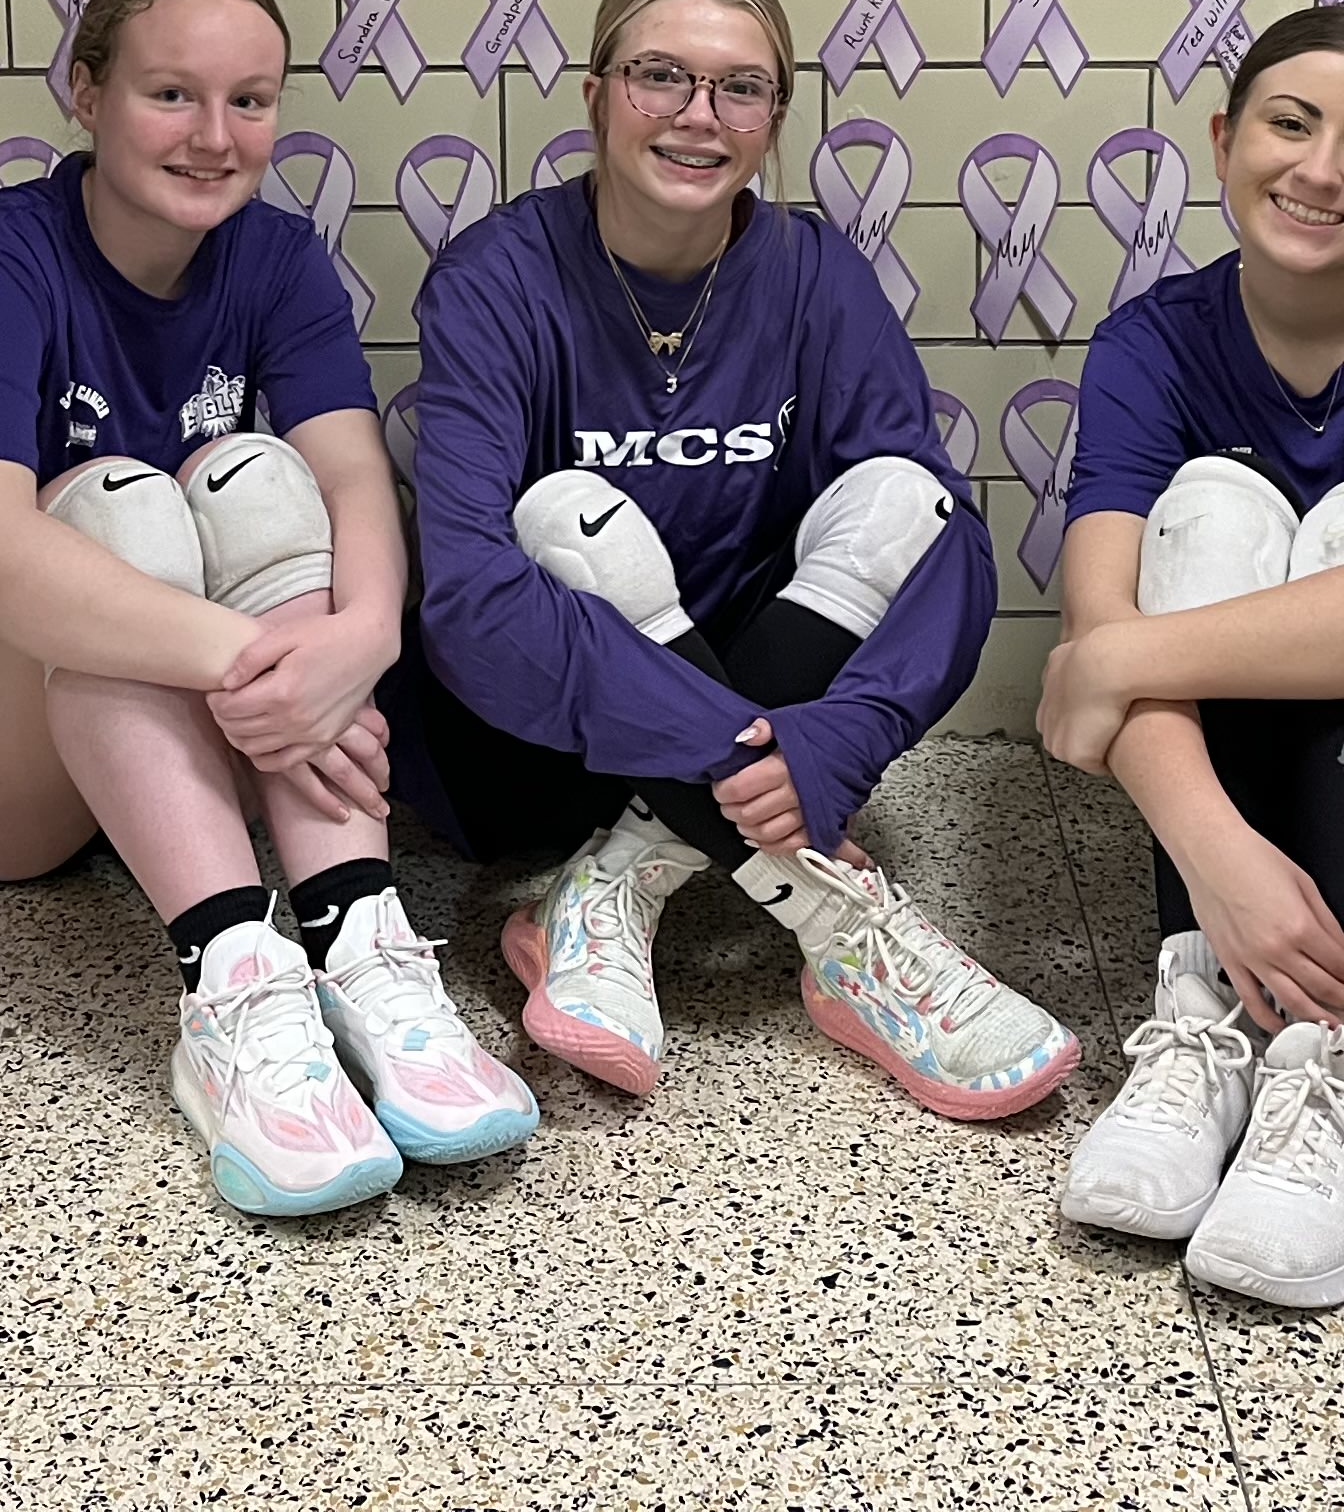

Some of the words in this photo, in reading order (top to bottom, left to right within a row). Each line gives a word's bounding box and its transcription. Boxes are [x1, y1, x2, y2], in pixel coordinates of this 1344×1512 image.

[338, 10, 379, 64] Sandra
[843, 12, 876, 49] Aunt
[1176, 29, 1204, 58] Ted
[75, 385, 110, 420] CANCER
[573, 423, 774, 467] MCS
